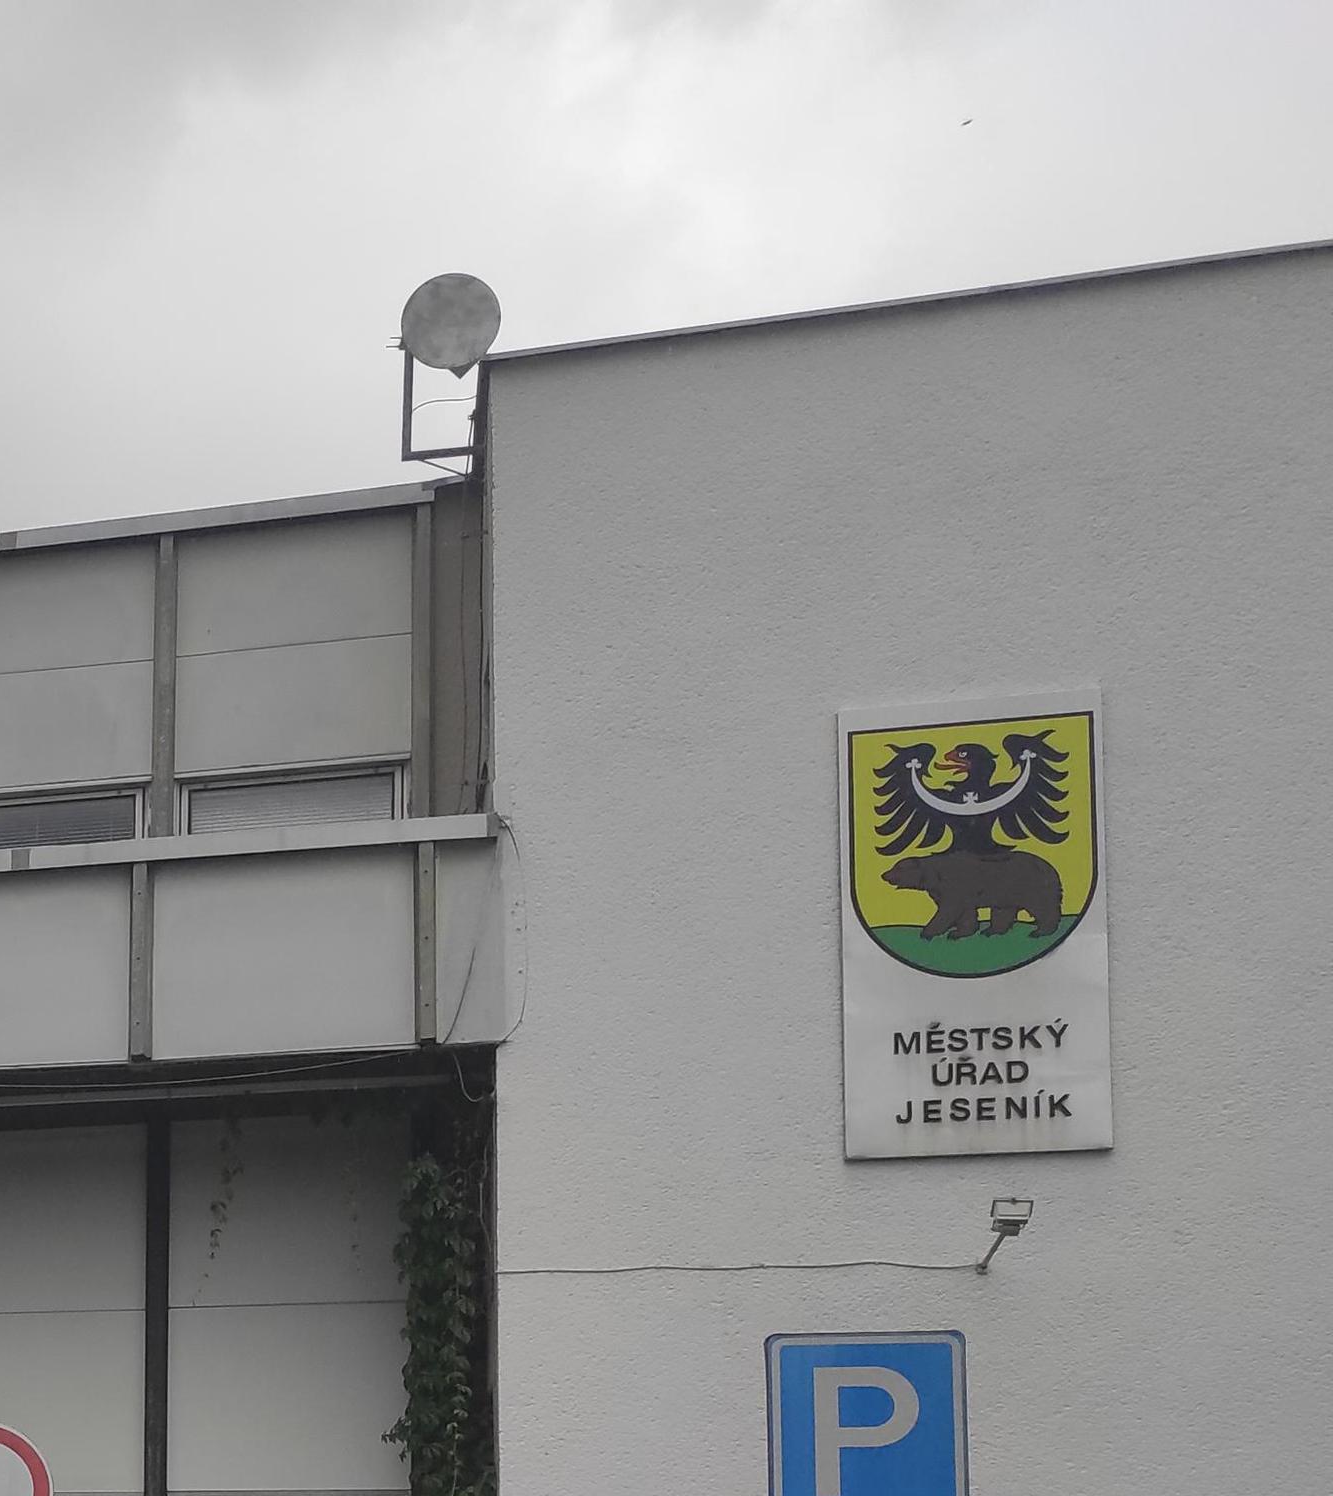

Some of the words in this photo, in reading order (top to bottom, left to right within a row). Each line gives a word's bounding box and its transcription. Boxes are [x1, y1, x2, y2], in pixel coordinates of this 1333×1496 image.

[893, 1018, 1069, 1055] MĚSTSKÝ
[932, 1056, 1029, 1086] ÚŘAD
[896, 1089, 1072, 1124] JESENÍK
